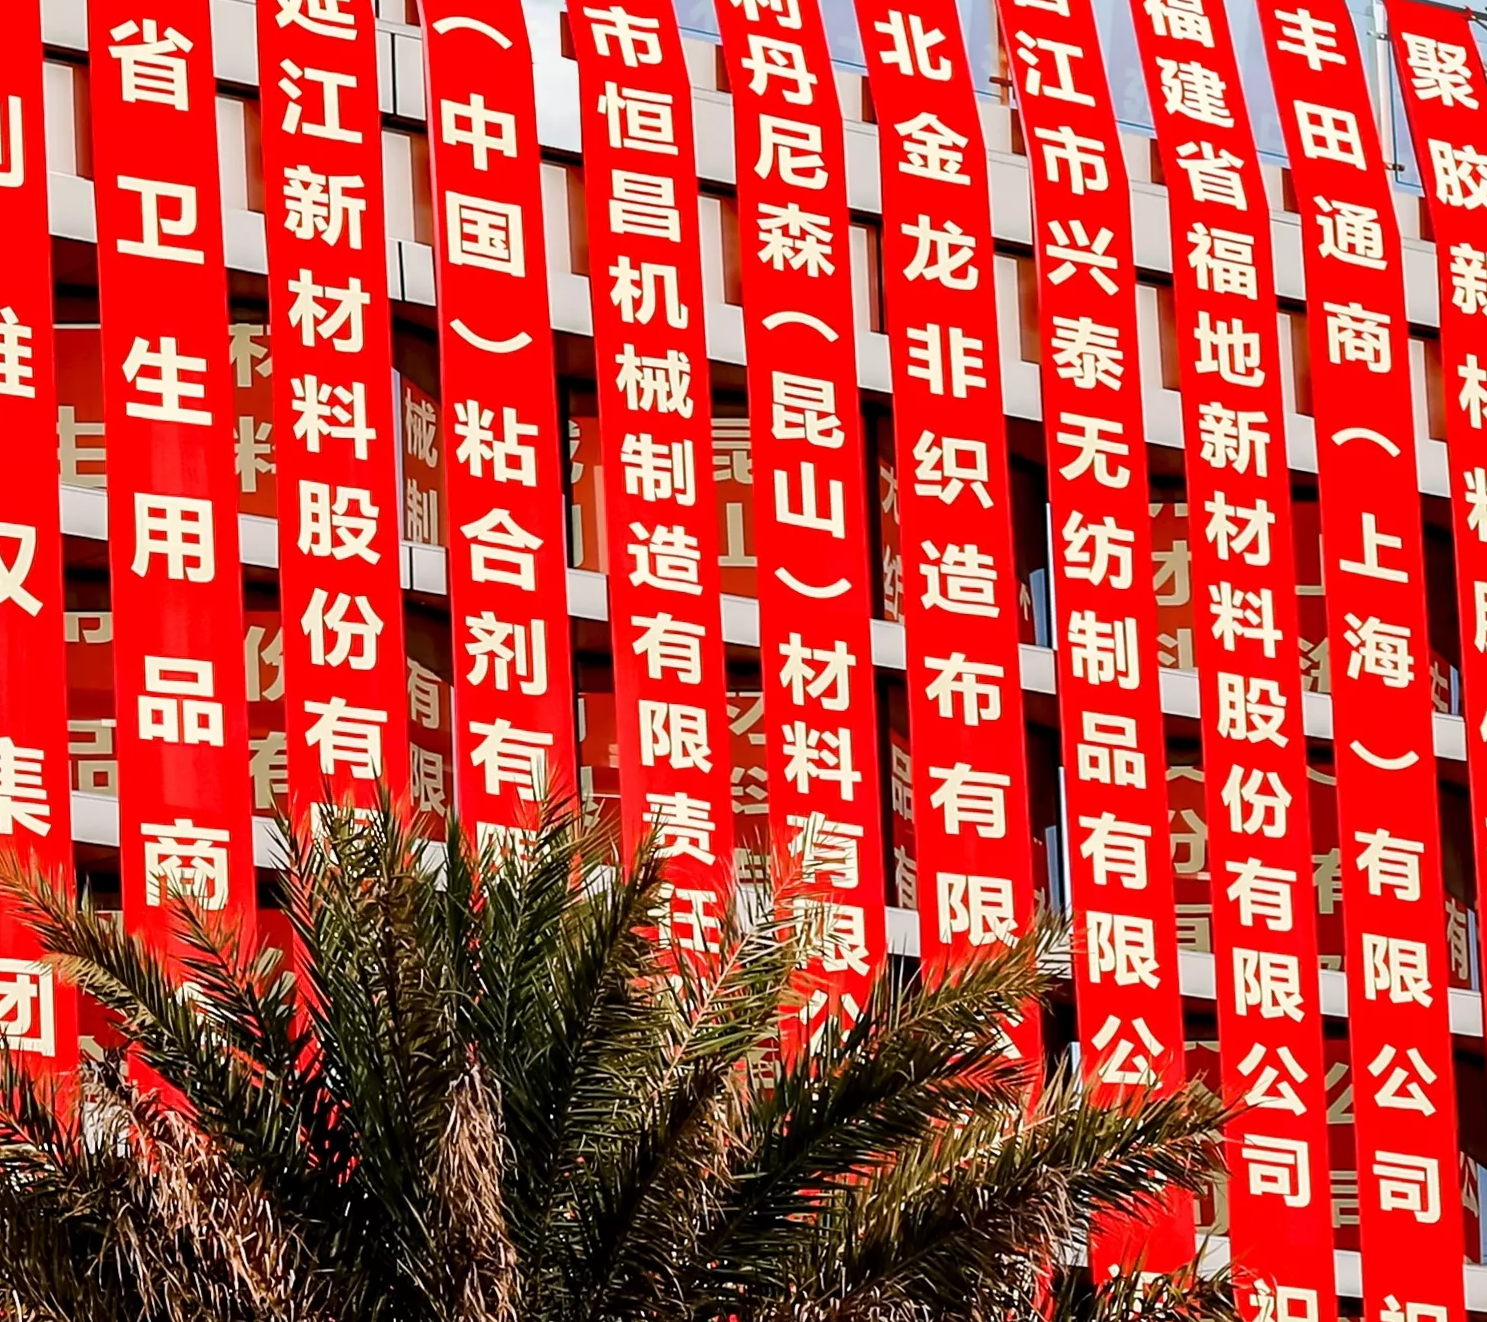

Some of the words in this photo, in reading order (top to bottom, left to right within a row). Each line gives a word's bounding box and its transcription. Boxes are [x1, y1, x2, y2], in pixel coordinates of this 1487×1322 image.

[1275, 10, 1441, 1223] 丰田通商（上海）有限公司
